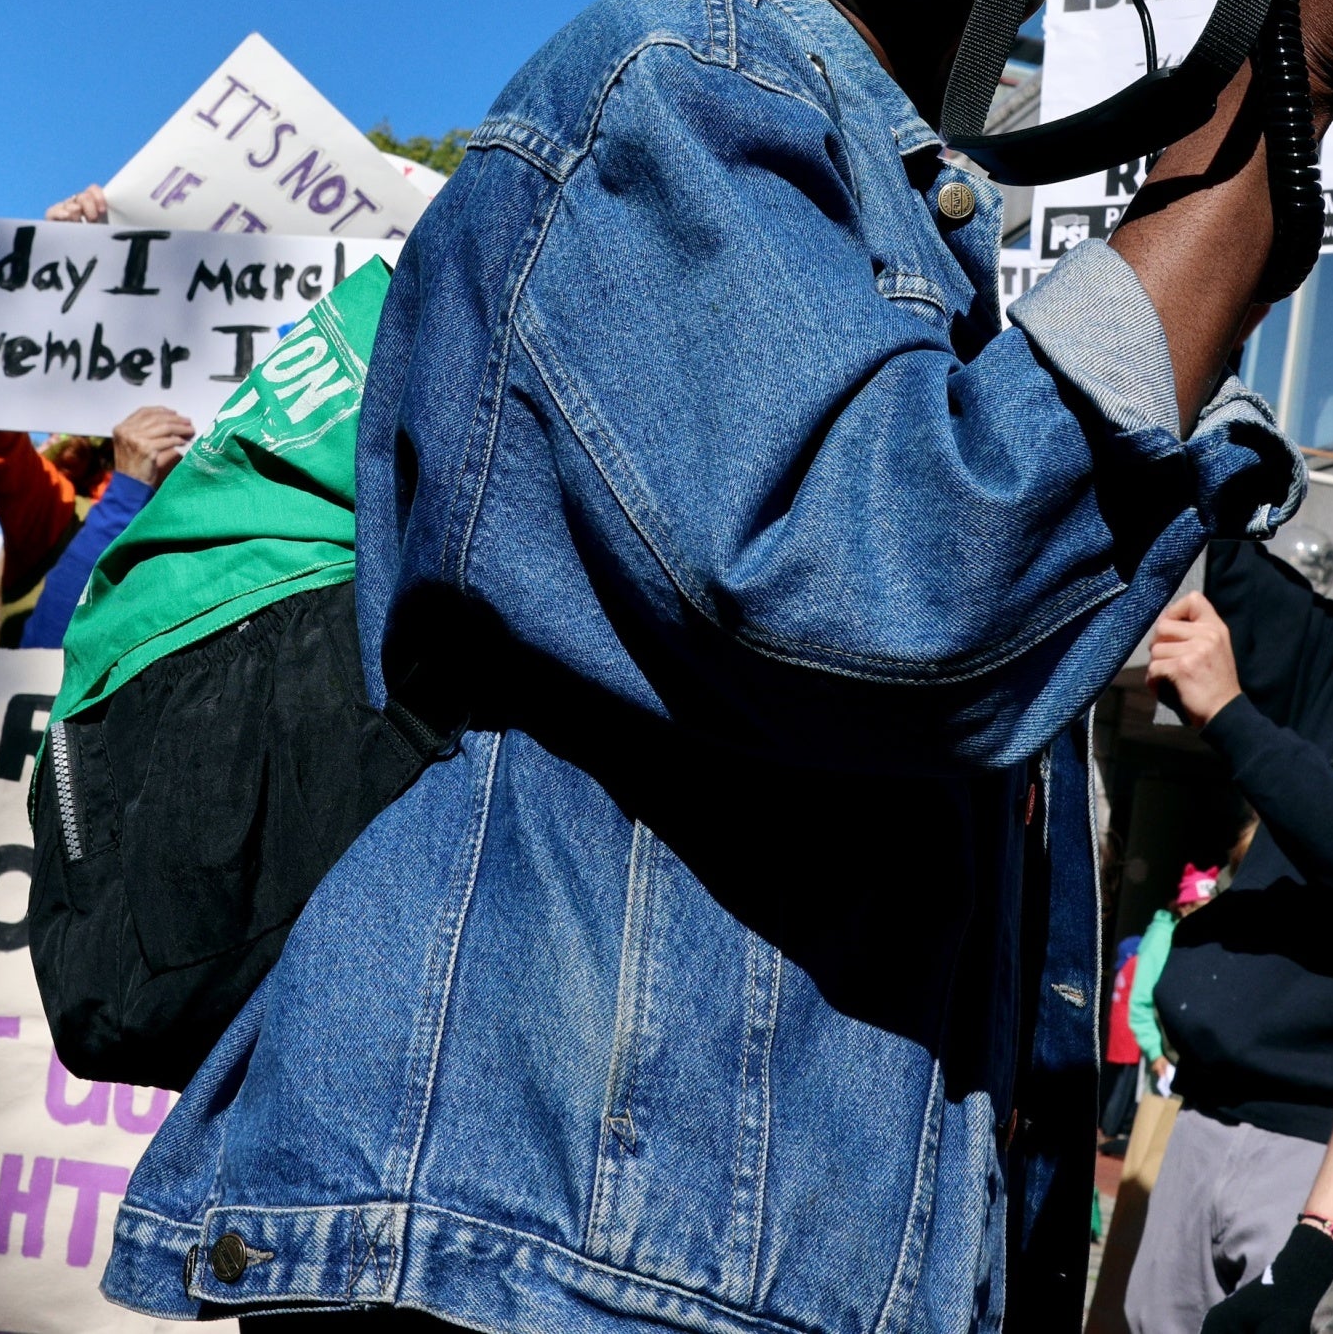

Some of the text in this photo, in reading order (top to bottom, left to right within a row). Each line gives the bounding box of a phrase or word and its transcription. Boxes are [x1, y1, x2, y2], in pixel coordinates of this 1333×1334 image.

[196, 75, 378, 233] IT'S NOT
[150, 166, 204, 209] IF
[102, 230, 171, 296] I
[210, 324, 271, 382] I
